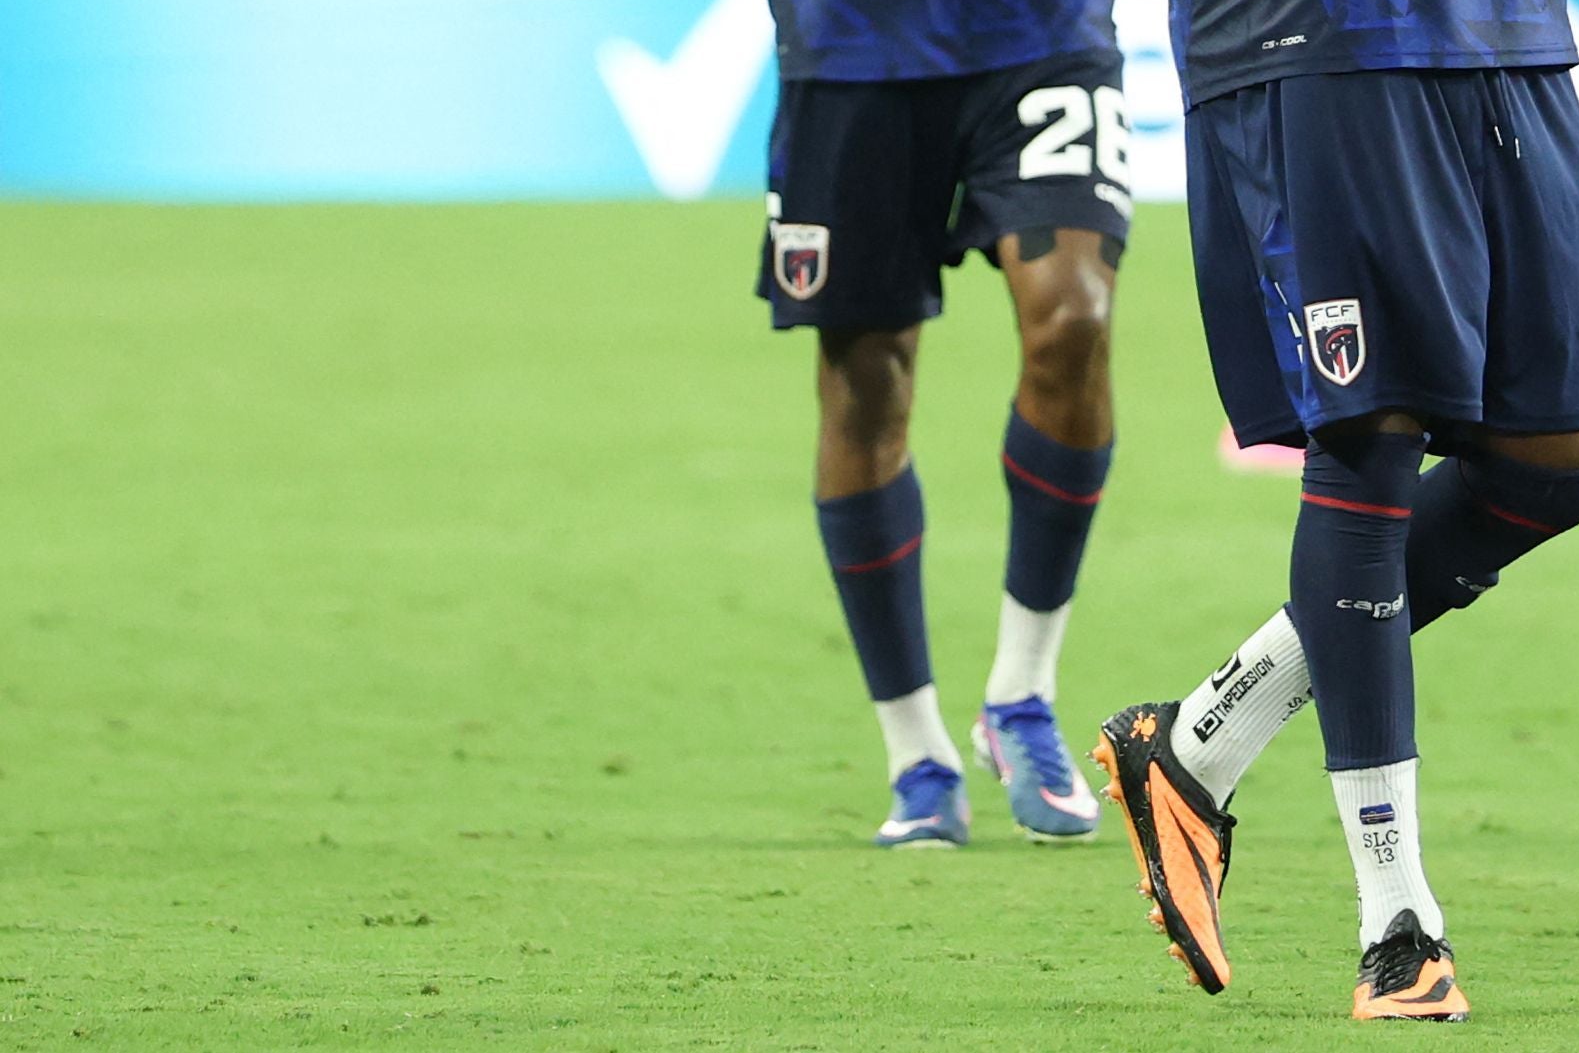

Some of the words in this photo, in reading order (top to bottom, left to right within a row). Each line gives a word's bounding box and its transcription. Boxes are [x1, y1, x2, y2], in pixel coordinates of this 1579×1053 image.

[1017, 85, 1131, 188] 26
[1311, 304, 1355, 322] FCF
[1215, 654, 1275, 717] TAPEDESIGN
[1363, 829, 1399, 848] SLC
[1374, 848, 1395, 865] 13
